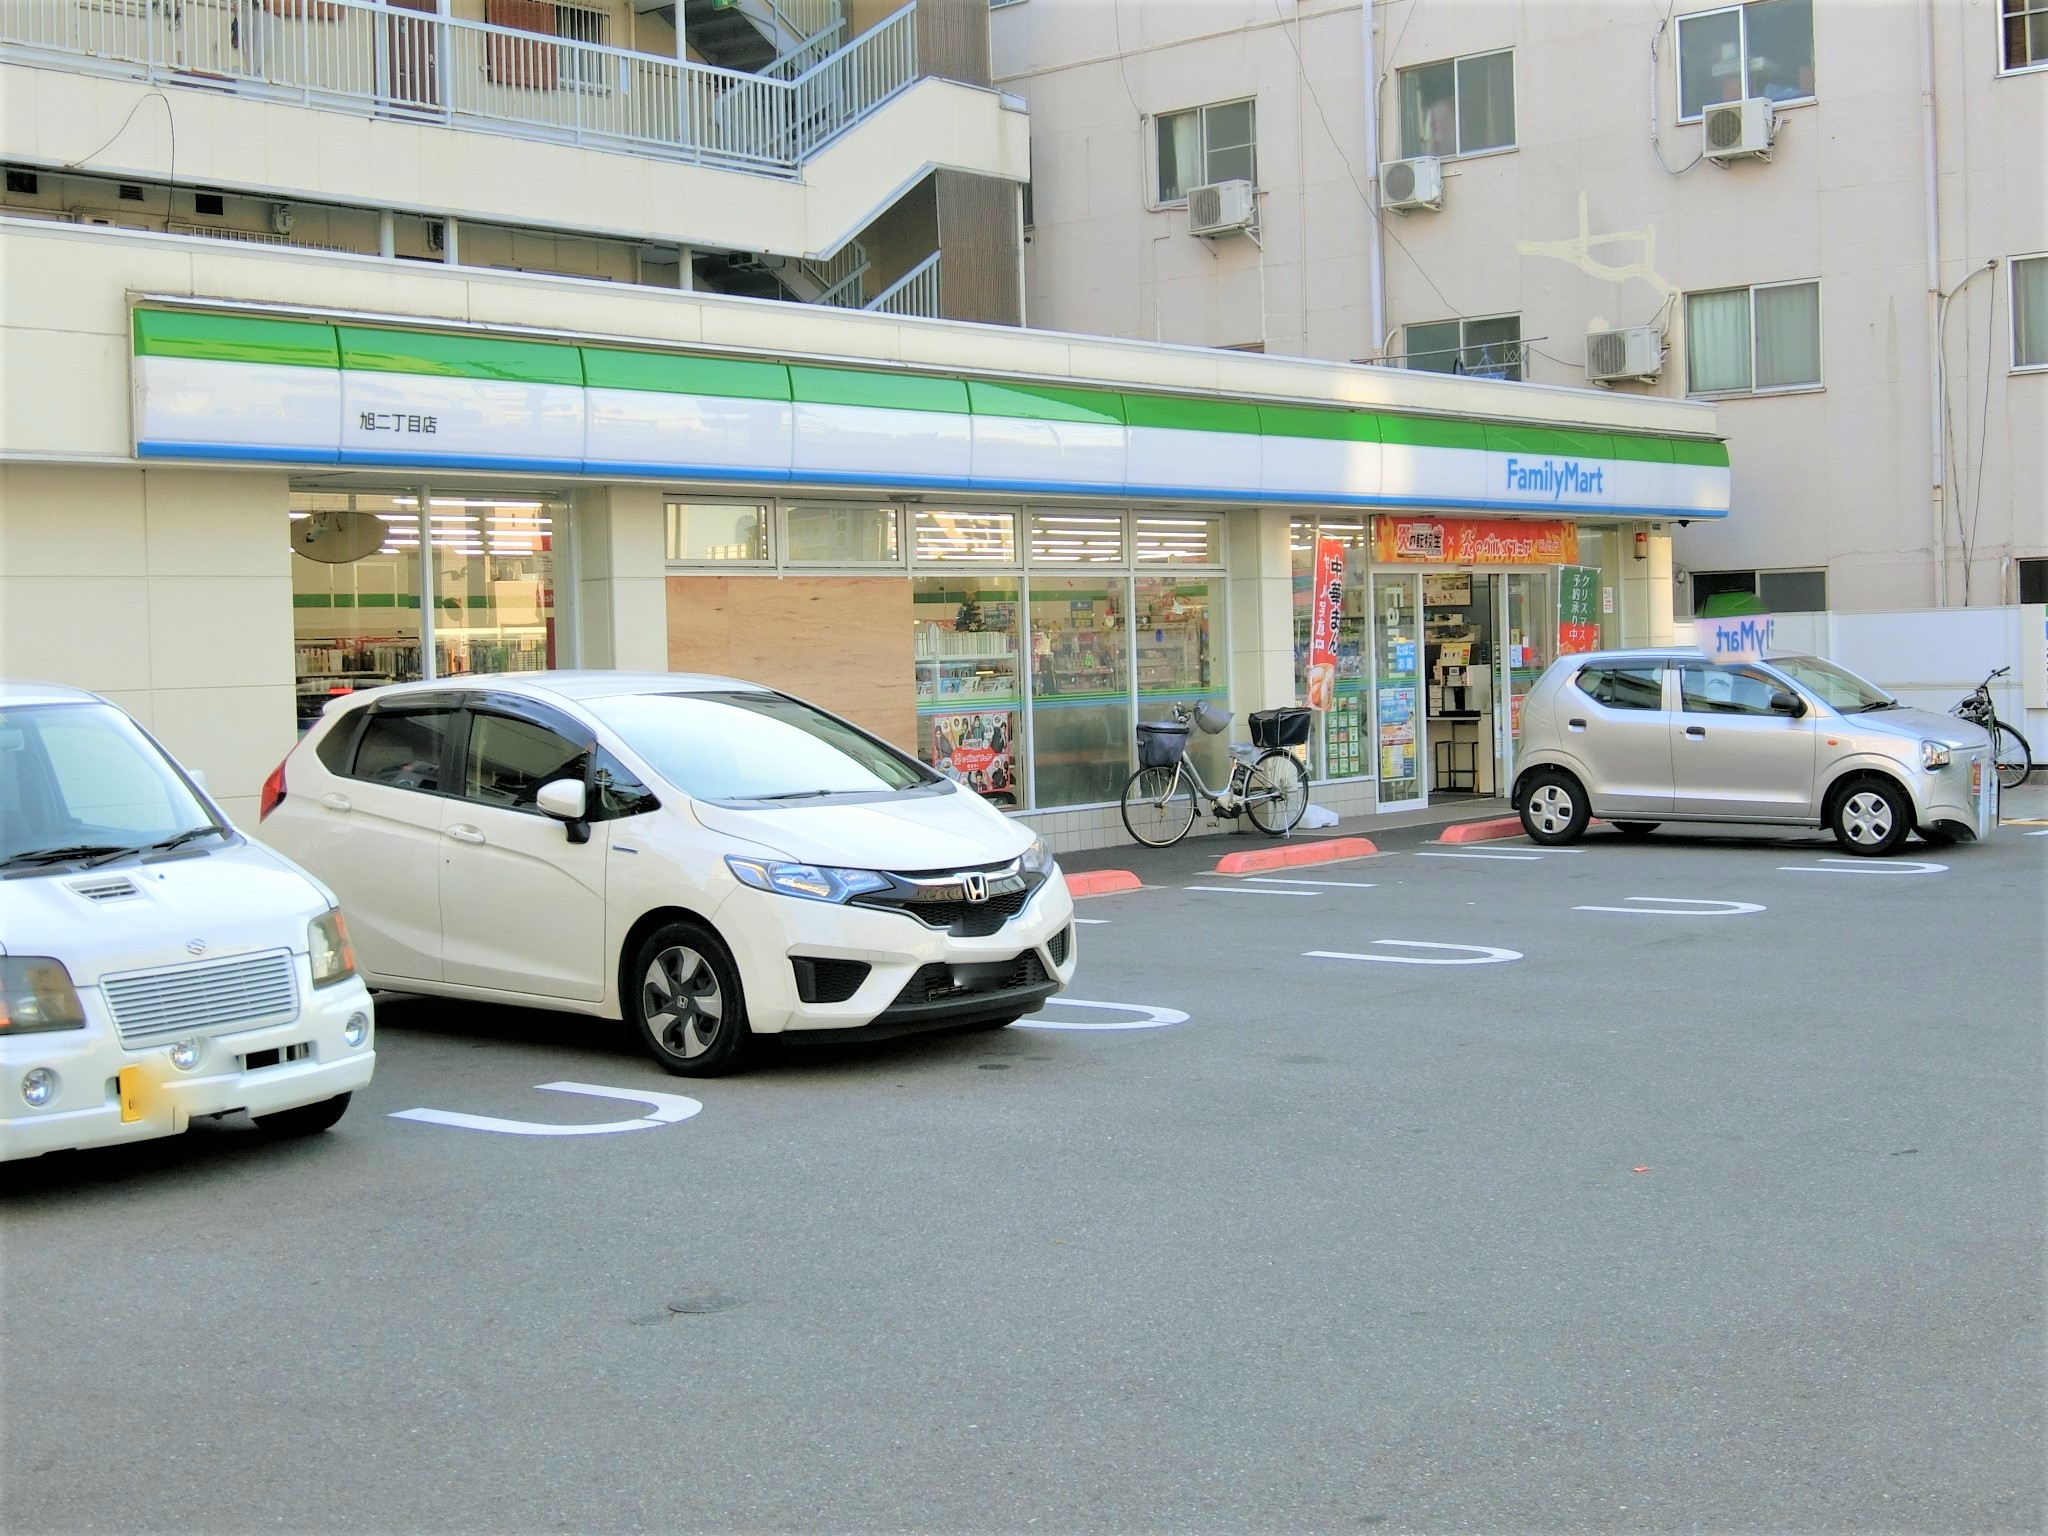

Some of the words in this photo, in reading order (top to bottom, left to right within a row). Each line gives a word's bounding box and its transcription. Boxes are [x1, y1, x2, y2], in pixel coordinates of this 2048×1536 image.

[360, 411, 438, 434] 旭二丁目店
[1507, 458, 1603, 500] FamilyMart
[1328, 554, 1343, 655] 中華まん
[1568, 574, 1581, 642] 予約承り中
